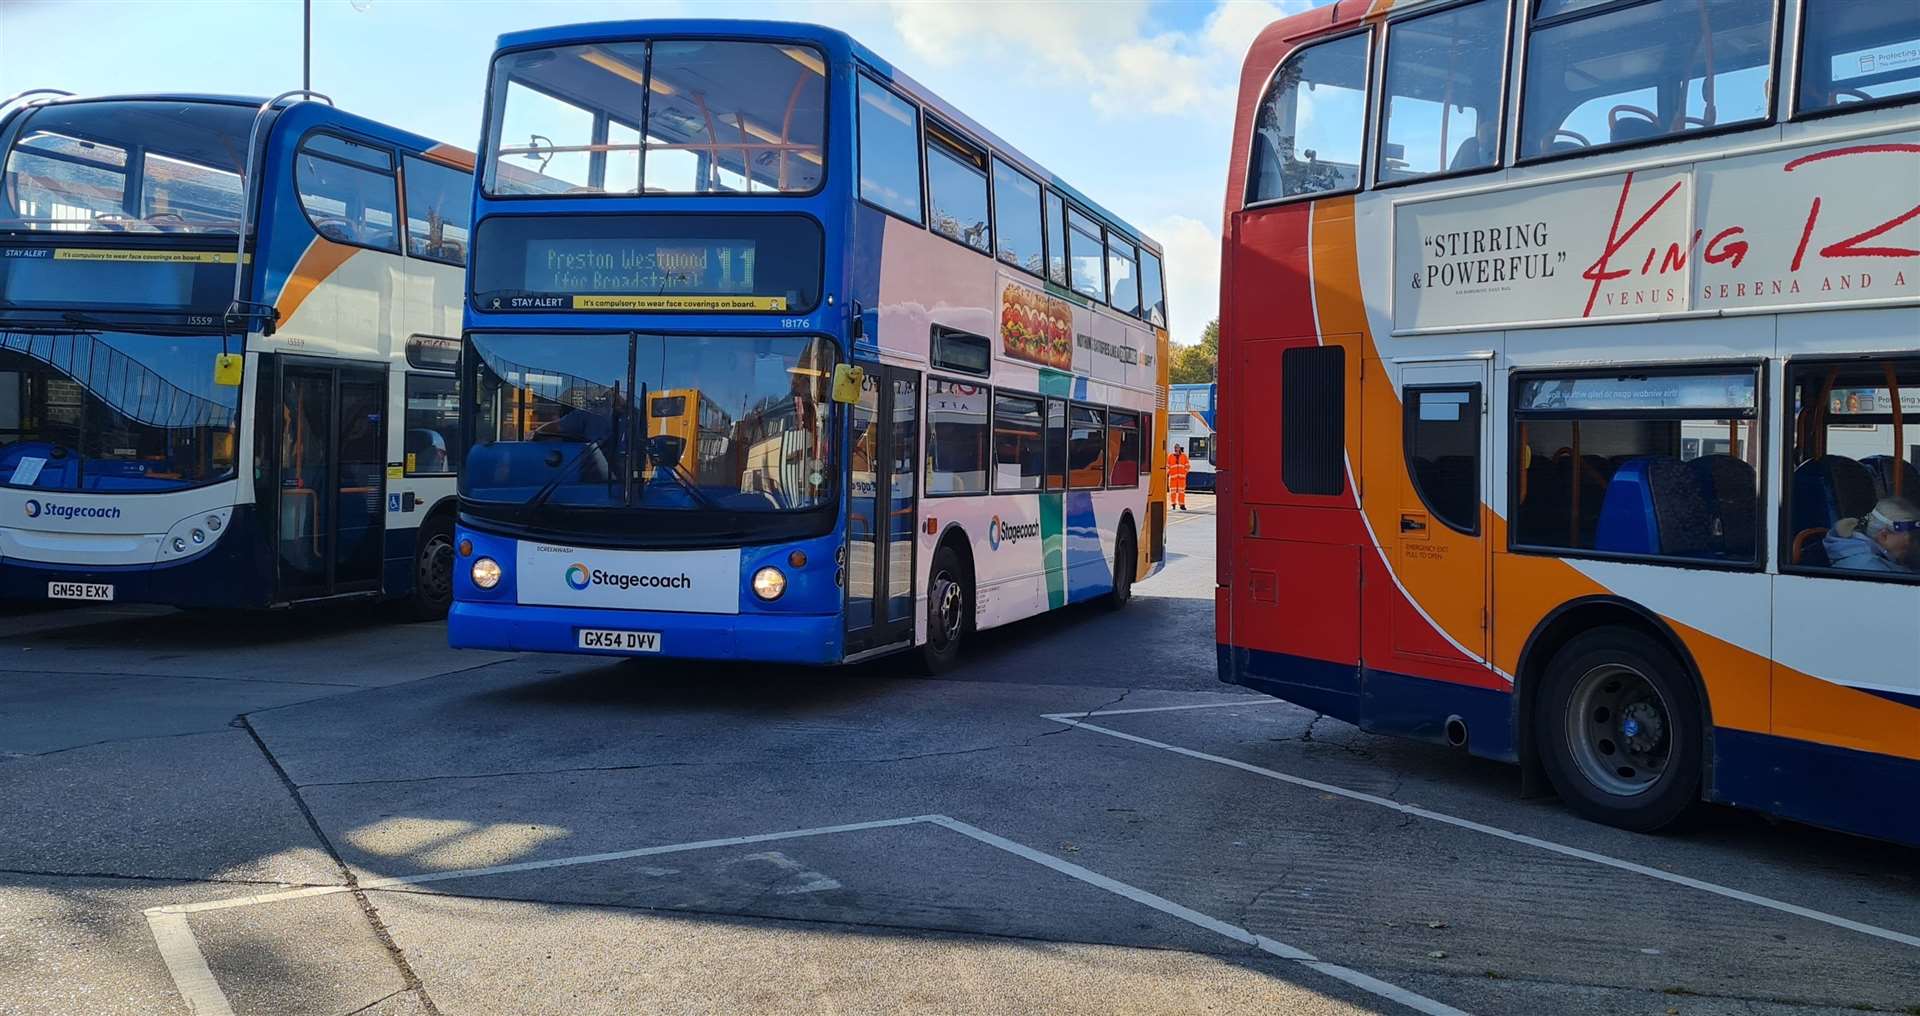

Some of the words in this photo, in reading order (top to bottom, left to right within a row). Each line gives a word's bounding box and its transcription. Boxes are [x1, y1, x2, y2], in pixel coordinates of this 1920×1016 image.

[1425, 222, 1548, 257] “STIRRING
[5, 249, 23, 257] STAY
[24, 249, 48, 257] ALERT
[548, 249, 613, 270] Preston
[717, 248, 755, 289] 11
[1411, 272, 1422, 289] &
[1703, 279, 1801, 299] SERENA
[1821, 272, 1873, 291] AND
[511, 298, 532, 307] STAY
[535, 298, 563, 307] ALERT
[583, 299, 593, 307] It's
[595, 299, 636, 309] compulsory
[637, 300, 646, 308] to
[666, 299, 682, 308] face
[684, 300, 720, 310] coverings
[731, 300, 757, 308] board.
[187, 316, 213, 325] 15559
[781, 318, 810, 329] 18176
[44, 503, 121, 520] Stagecoach
[1001, 519, 1039, 544] Stagecoach
[592, 569, 691, 590] Stagecoach
[53, 584, 83, 597] GN59
[86, 586, 109, 598] EXK
[585, 631, 622, 647] GX54
[627, 634, 655, 649] DVV
